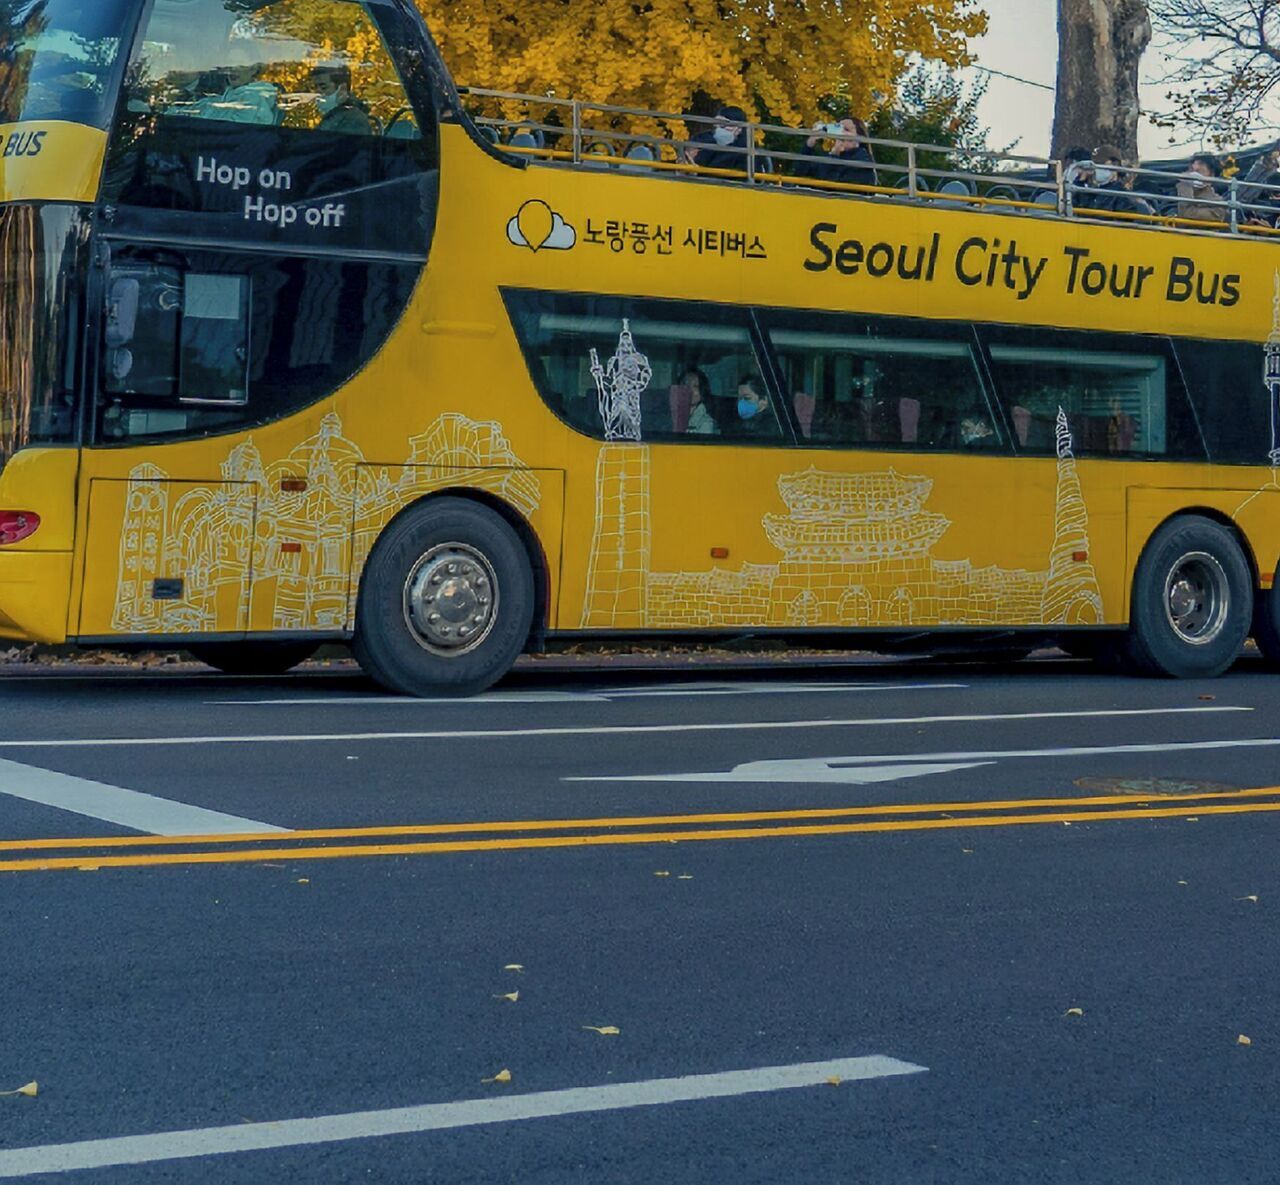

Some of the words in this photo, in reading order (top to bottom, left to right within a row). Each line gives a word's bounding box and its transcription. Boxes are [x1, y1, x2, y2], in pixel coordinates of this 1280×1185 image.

[3, 131, 47, 157] BUS
[196, 156, 250, 190] Hop
[259, 169, 291, 190] on
[244, 195, 297, 228] Hop
[304, 203, 346, 228] off
[583, 218, 673, 255] 노랑풍선
[682, 228, 768, 259] 시티버스
[803, 222, 940, 282] Seoul
[955, 236, 1048, 300] City
[1063, 246, 1154, 299] Tour
[1166, 256, 1241, 307] Bus
